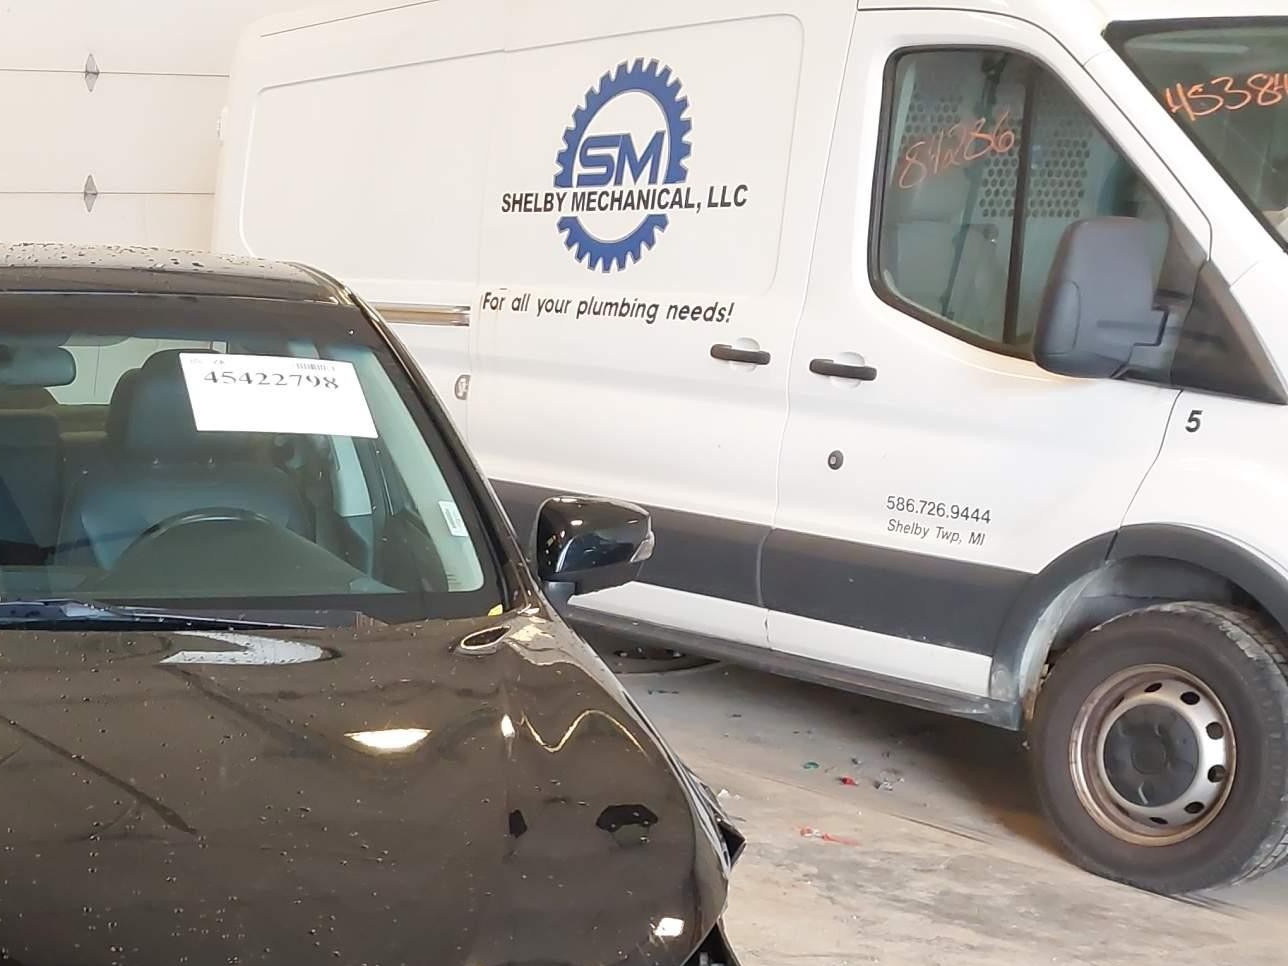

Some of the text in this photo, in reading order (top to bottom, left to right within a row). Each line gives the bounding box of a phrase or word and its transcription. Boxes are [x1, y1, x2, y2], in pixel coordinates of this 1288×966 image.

[576, 130, 666, 187] SM
[501, 184, 748, 213] SHELBY MECHANICAL, LLC
[482, 292, 735, 324] For all your plumbing needs!
[203, 371, 339, 390] 45422798
[1185, 410, 1203, 433] 5
[886, 496, 991, 524] 586.726.9444
[887, 519, 985, 546] Shelby Twp, MI
